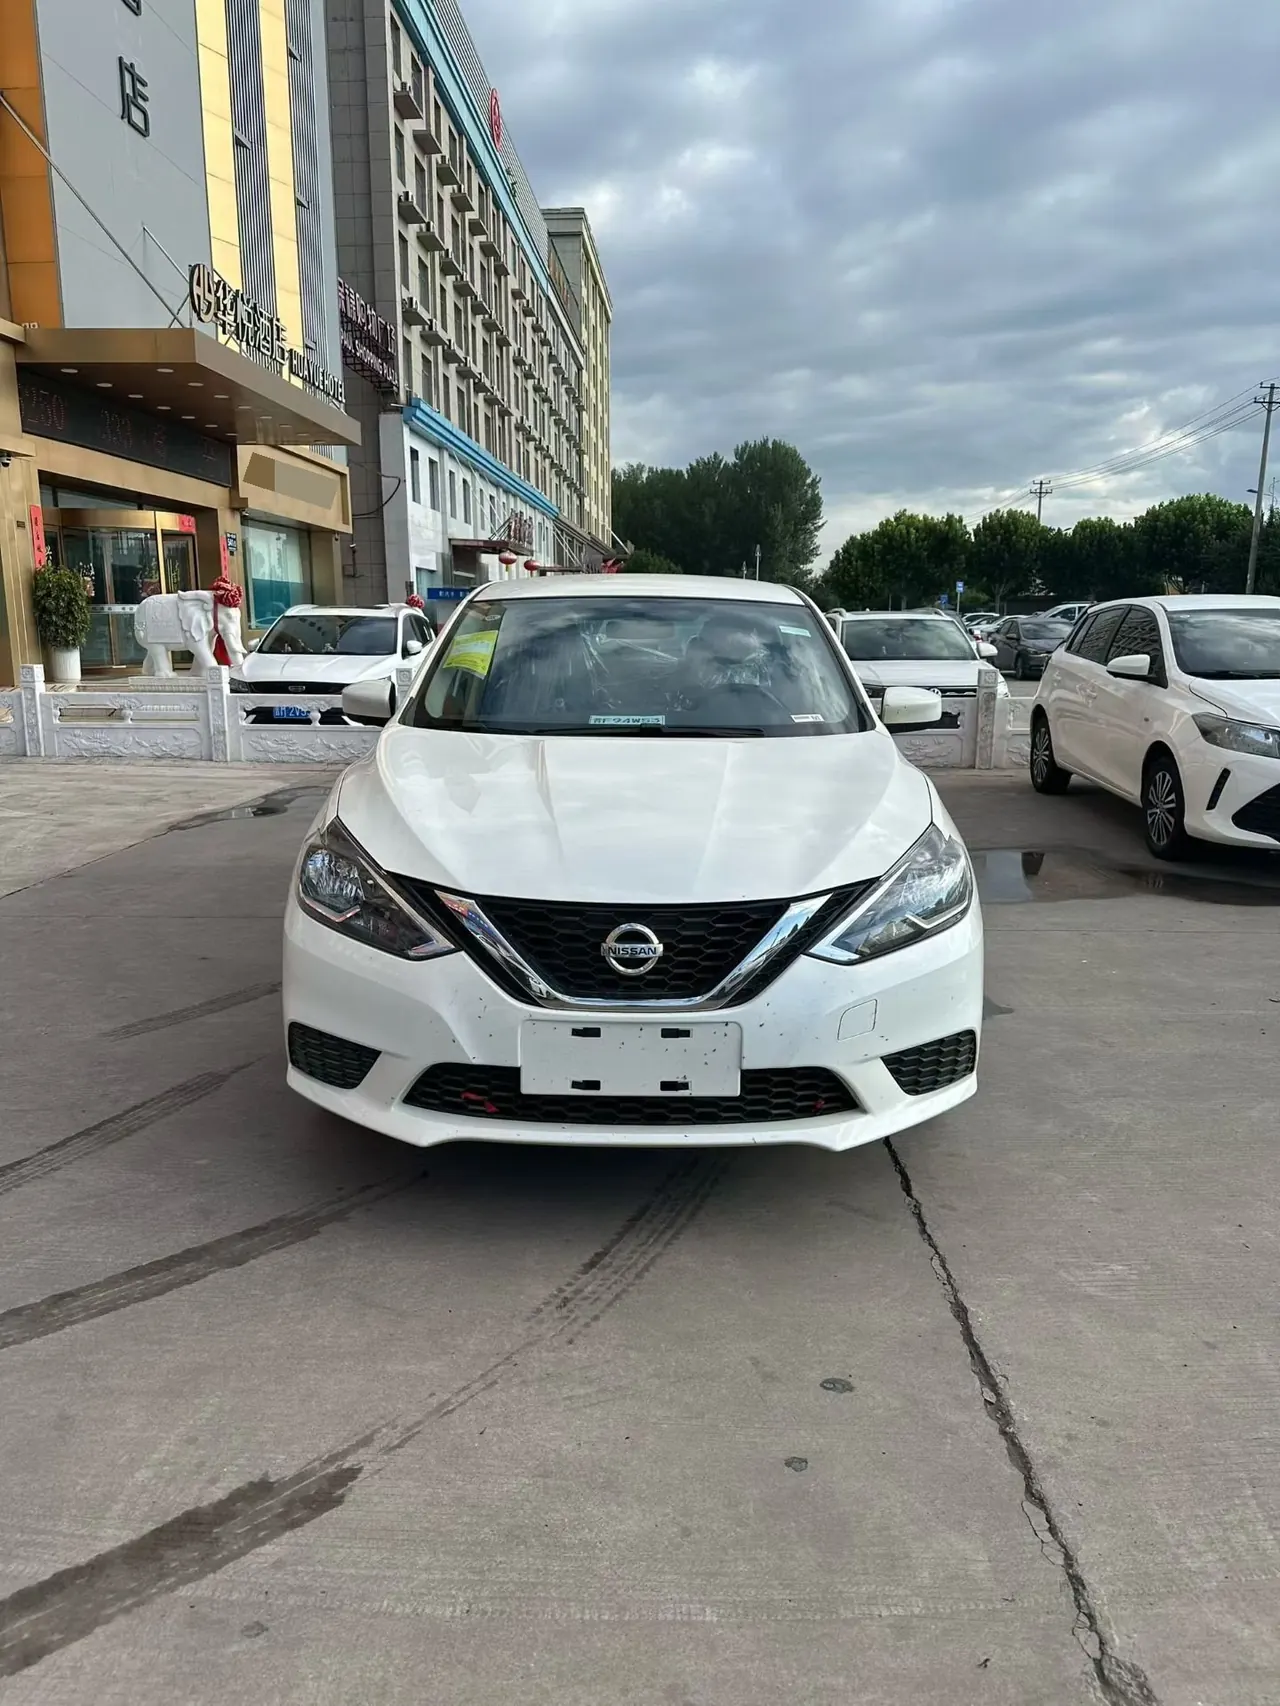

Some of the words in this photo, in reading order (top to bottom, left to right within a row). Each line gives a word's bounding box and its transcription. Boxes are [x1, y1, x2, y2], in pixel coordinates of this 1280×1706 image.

[213, 278, 287, 366] 华悦酒店
[324, 368, 346, 403] HOTEL
[608, 946, 657, 956] NISSAN
